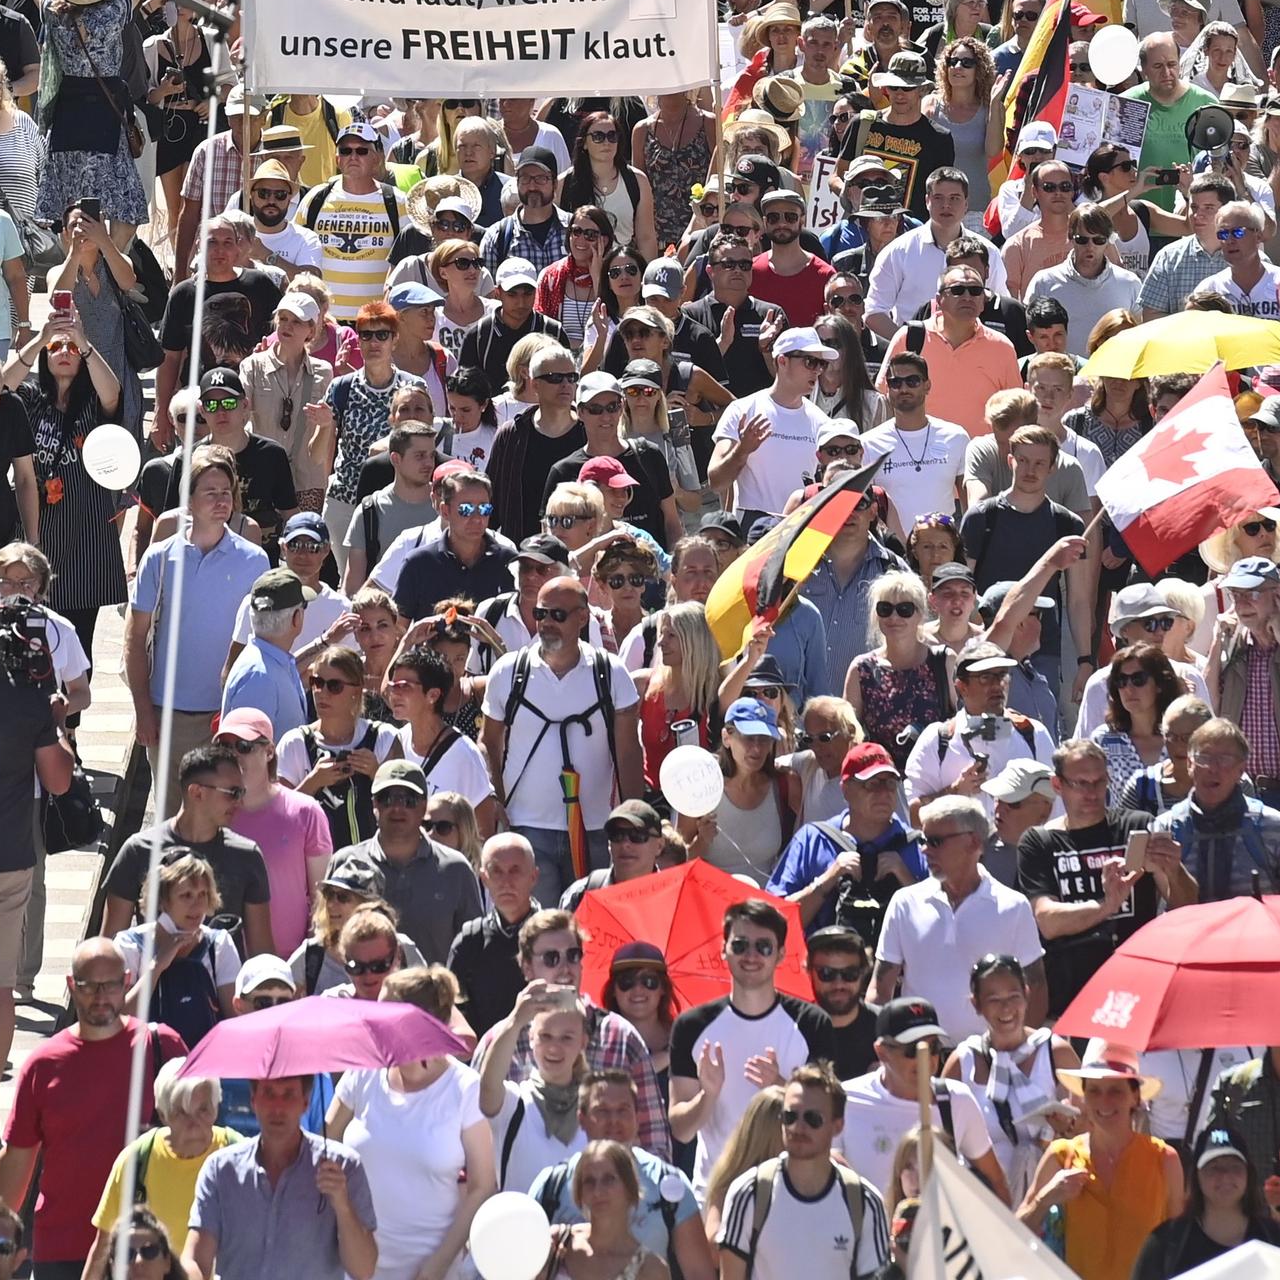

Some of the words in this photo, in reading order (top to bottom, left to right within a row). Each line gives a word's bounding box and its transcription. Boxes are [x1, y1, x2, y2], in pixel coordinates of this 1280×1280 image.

[912, 6, 929, 15] FOR
[913, 14, 930, 23] FOR
[279, 33, 393, 61] unsere
[401, 28, 577, 61] FREIHEIT
[584, 30, 676, 60] klaut.
[812, 197, 839, 229] ist
[317, 219, 390, 234] GENERATION
[372, 235, 384, 247] 86
[210, 371, 225, 385] NY
[38, 418, 56, 433] MY
[1057, 854, 1082, 874] GIB
